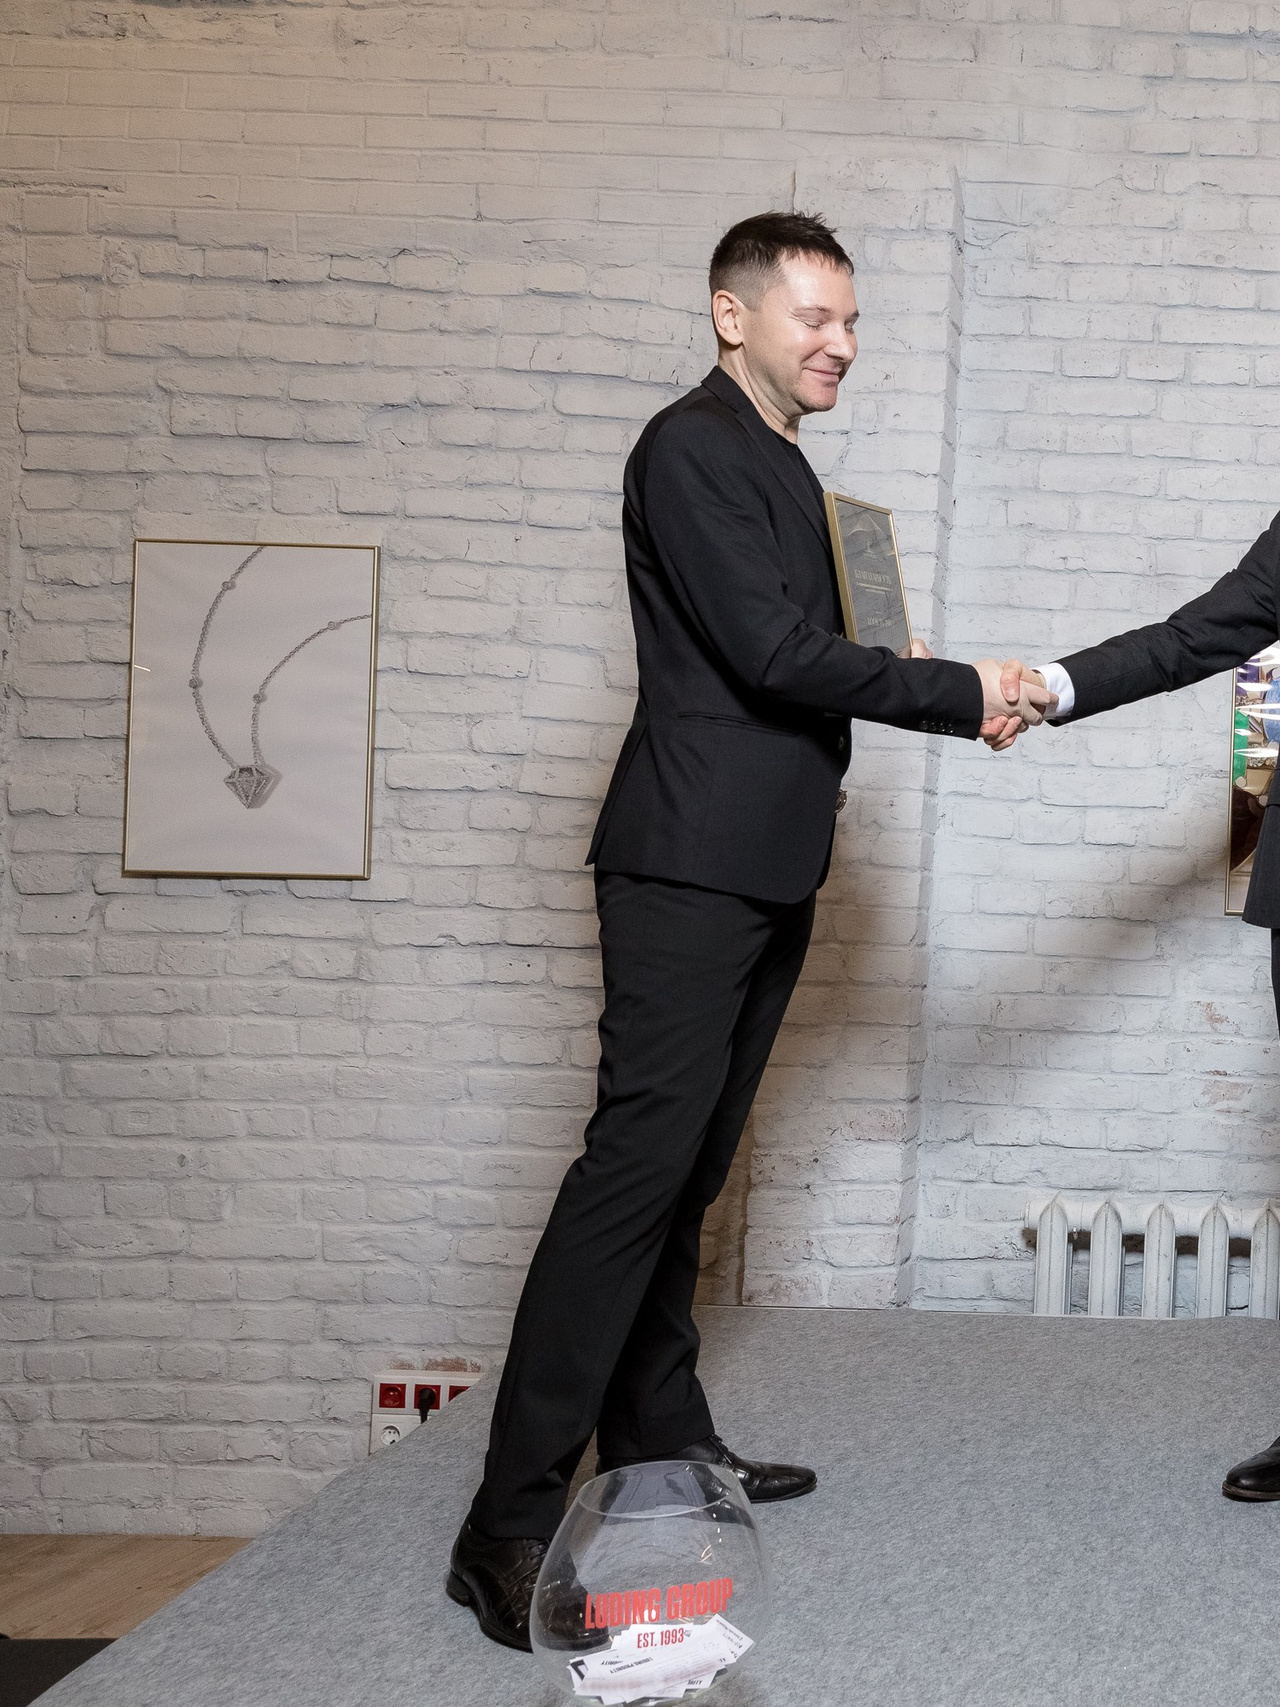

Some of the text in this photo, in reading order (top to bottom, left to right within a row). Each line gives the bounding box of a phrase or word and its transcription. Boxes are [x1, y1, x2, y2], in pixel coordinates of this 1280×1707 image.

[585, 1578, 733, 1629] LUDING GROUP
[637, 1627, 685, 1649] EST. 1993
